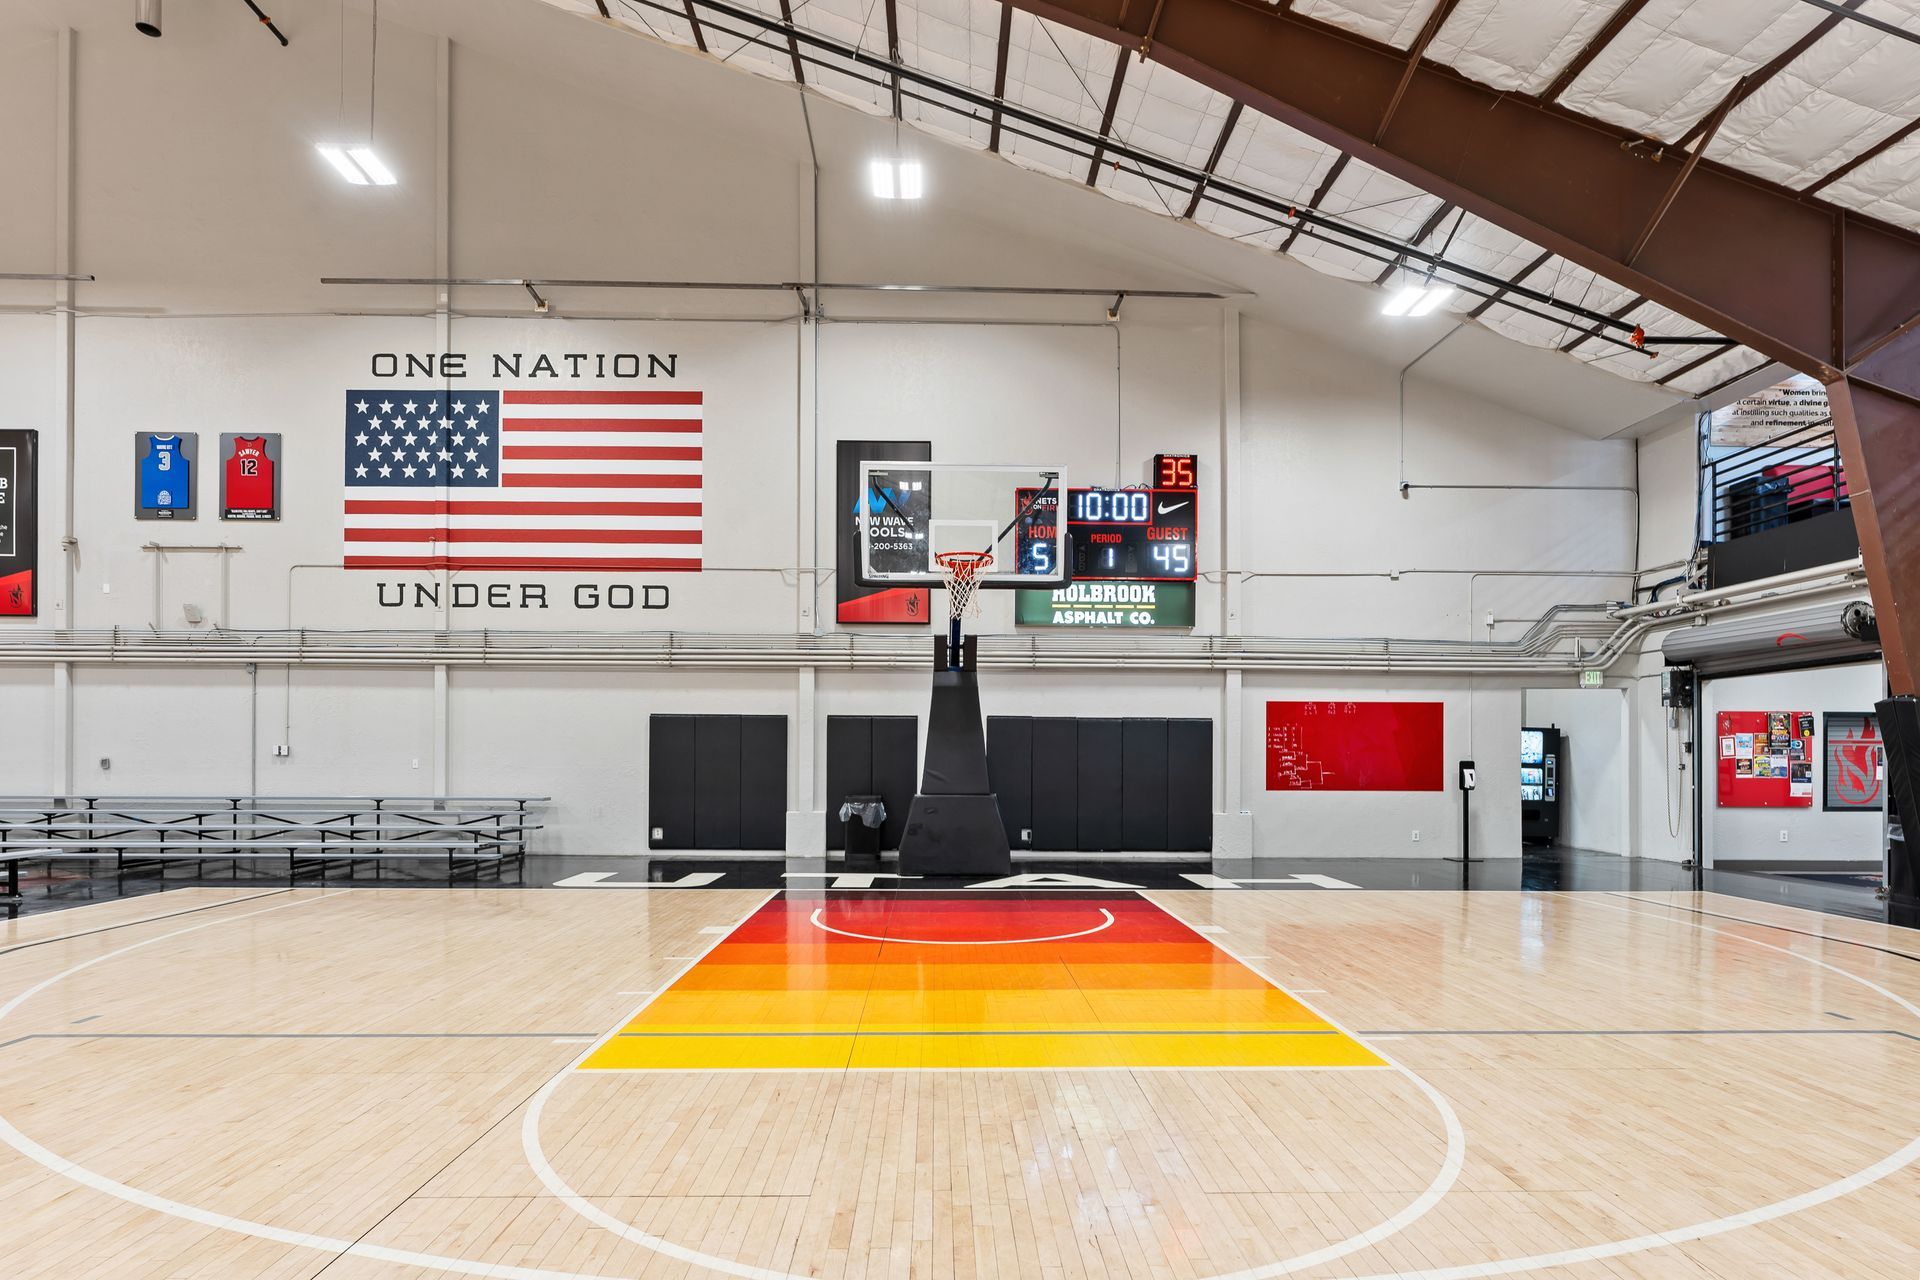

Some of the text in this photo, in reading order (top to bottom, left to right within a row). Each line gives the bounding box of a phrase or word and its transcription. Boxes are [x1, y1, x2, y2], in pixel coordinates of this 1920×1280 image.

[371, 353, 678, 379] ONE NATION
[1768, 399, 1791, 407] virtue,
[1740, 409, 1770, 417] instilling
[1789, 409, 1819, 418] qualities
[158, 451, 171, 471] 3
[240, 458, 258, 477] 12
[1162, 458, 1192, 486] 35
[1035, 497, 1057, 505] NETS
[1076, 493, 1147, 521] 10:00
[869, 527, 905, 537] OOLS
[1028, 526, 1057, 539] HOM
[1091, 533, 1122, 543] PERIOD
[1146, 527, 1188, 541] GUEST
[1033, 543, 1049, 570] 5
[1108, 547, 1114, 568] 1
[1153, 545, 1189, 572] 45
[376, 582, 670, 609] UNDER GOD
[1052, 584, 1156, 603] HOLBROOK
[1052, 611, 1155, 624] ASPHALT CO.
[1585, 671, 1601, 685] EXIT
[553, 872, 1363, 889] UTAH
